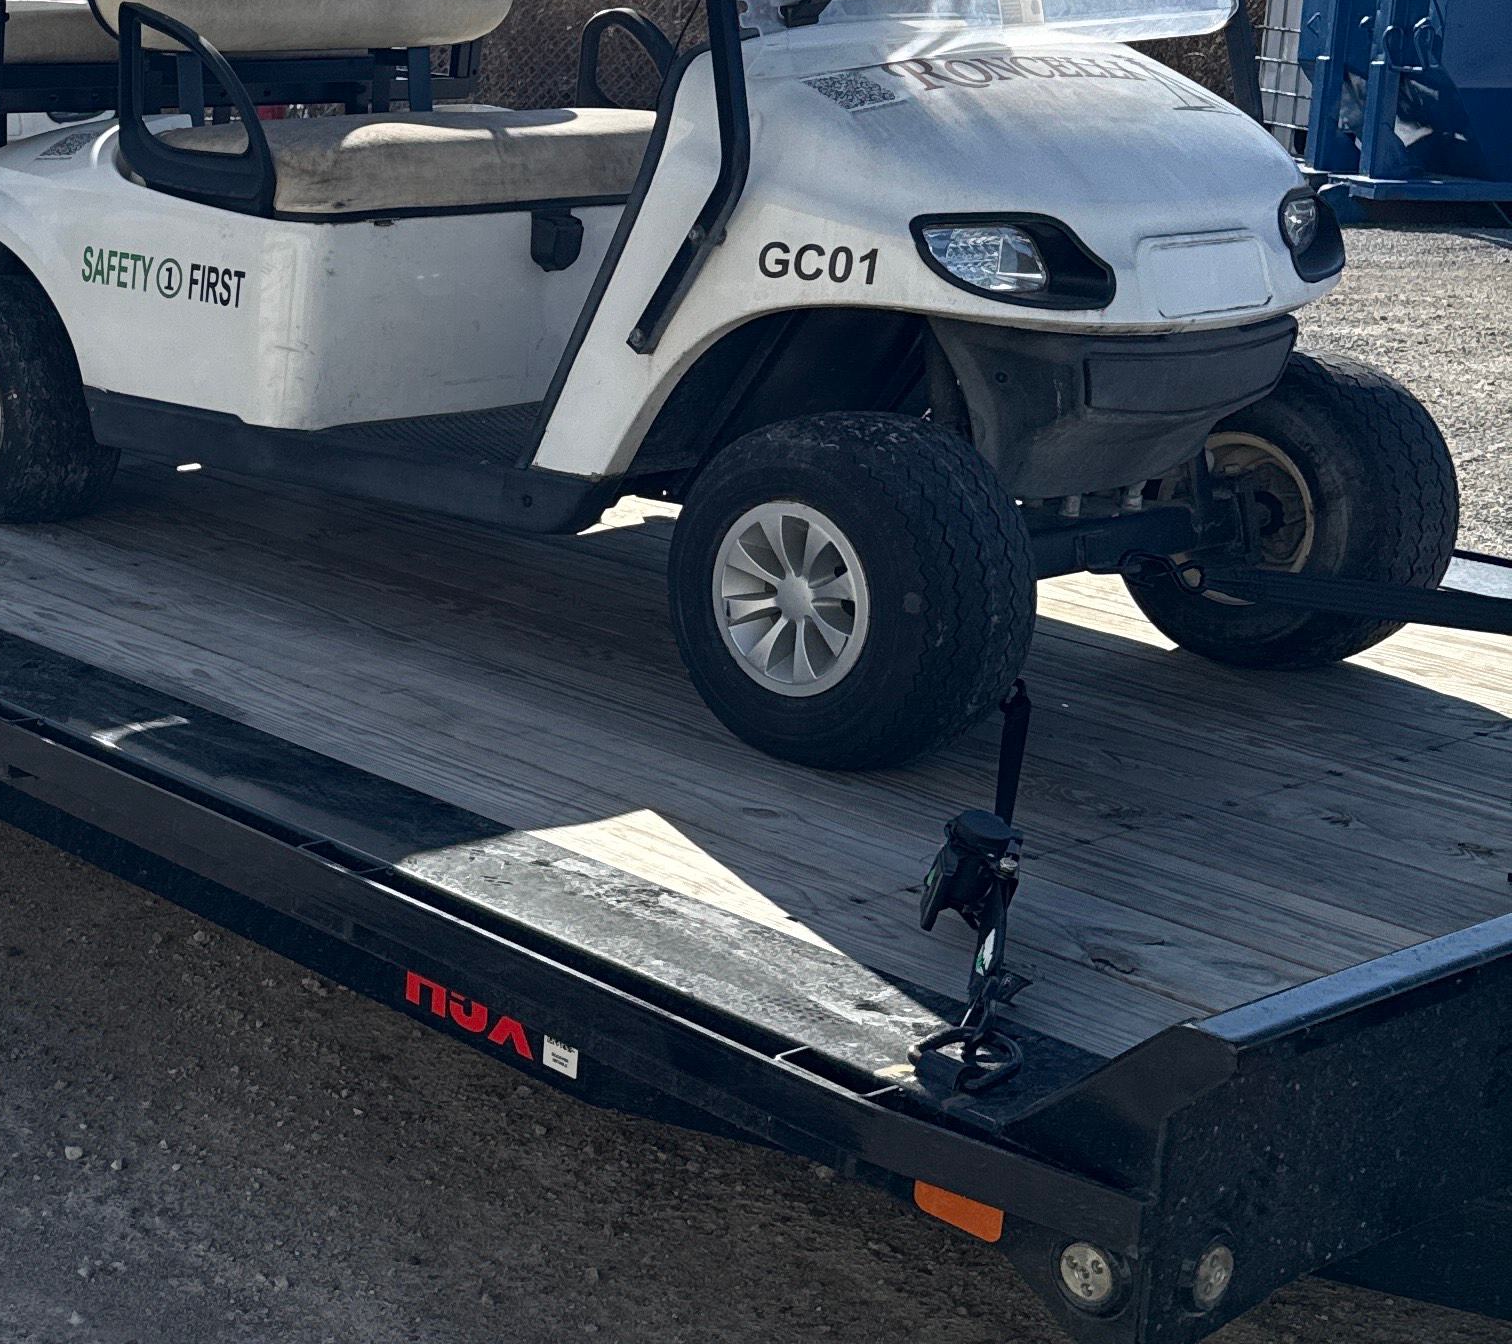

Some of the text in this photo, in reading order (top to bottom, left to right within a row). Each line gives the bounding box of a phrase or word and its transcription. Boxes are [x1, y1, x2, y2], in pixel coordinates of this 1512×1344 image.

[881, 56, 1147, 92] RONCELLI
[81, 245, 154, 292] SAFETY
[188, 263, 246, 308] FIRST
[758, 241, 879, 285] GC01
